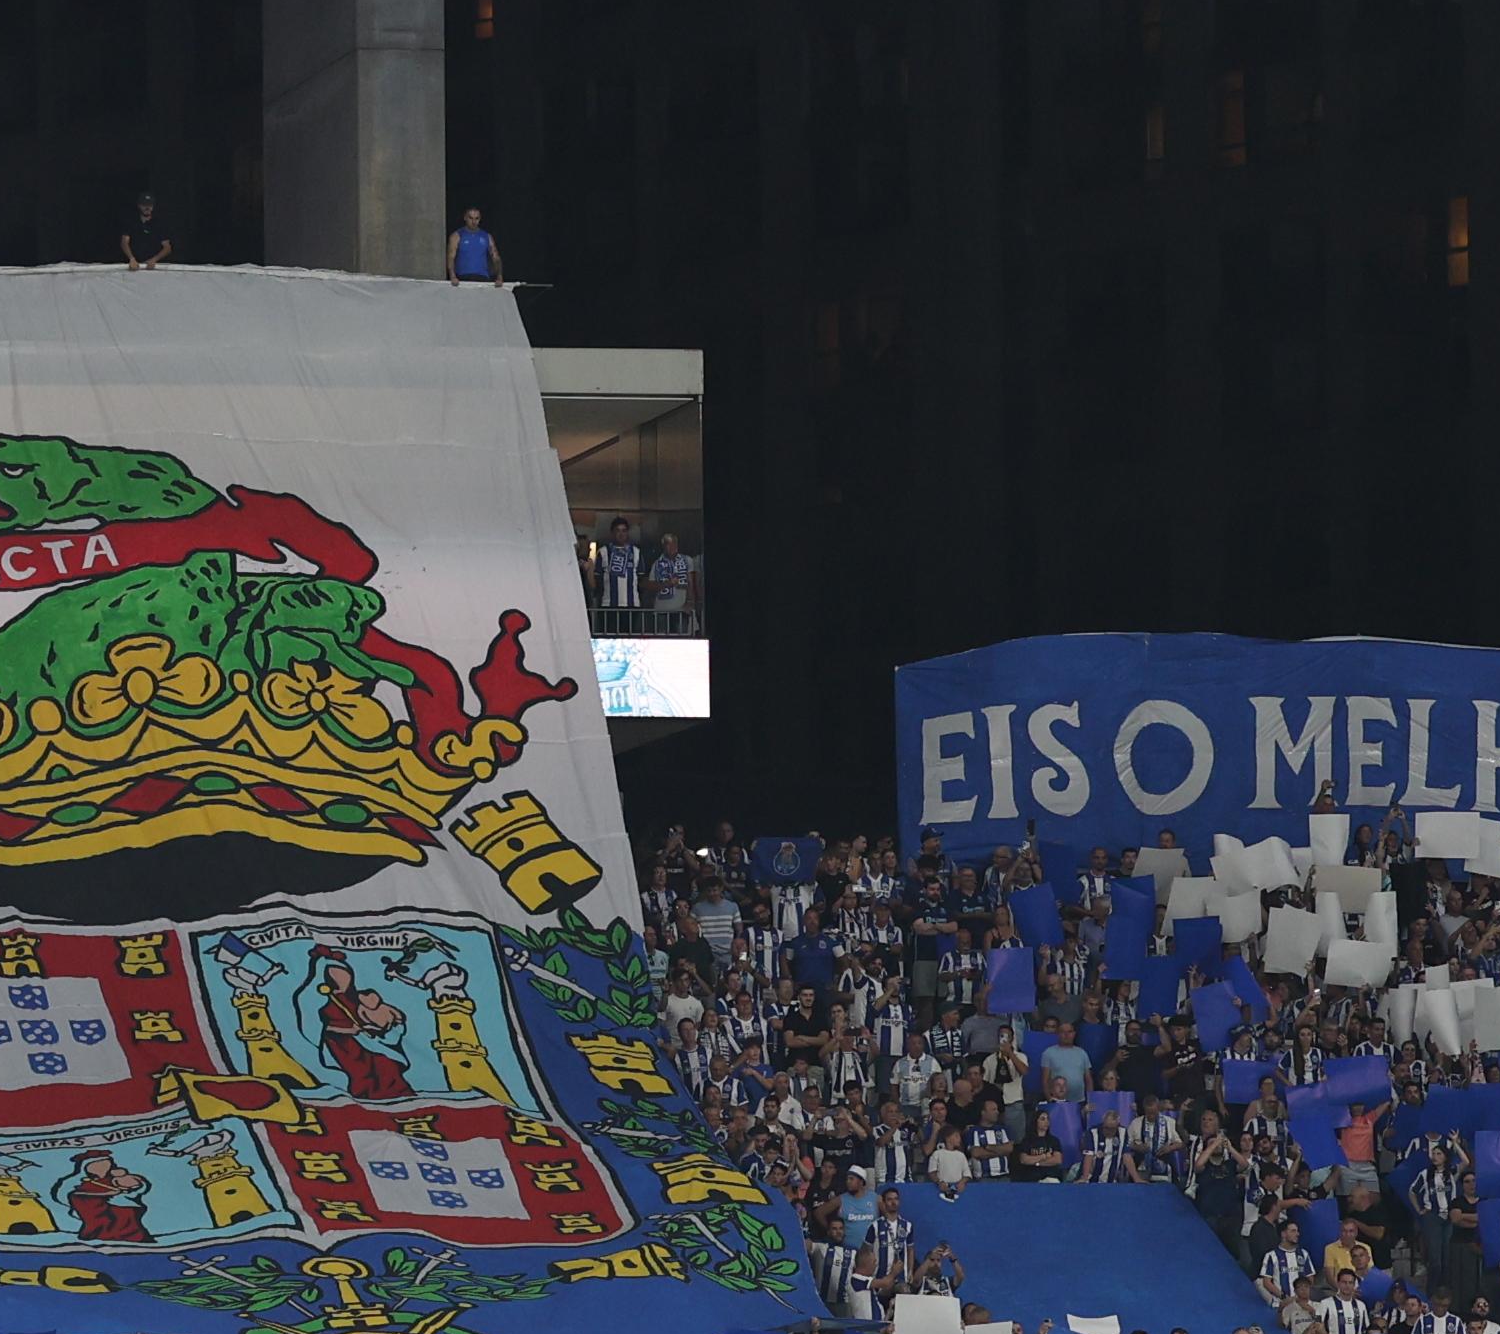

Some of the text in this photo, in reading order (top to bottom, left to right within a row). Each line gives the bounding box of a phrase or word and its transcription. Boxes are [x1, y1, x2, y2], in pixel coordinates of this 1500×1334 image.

[919, 699, 1091, 826] EIS
[1112, 699, 1214, 817] O
[247, 923, 410, 948] CIVITA VIRGINIS
[13, 1119, 182, 1152] CIVITAS VIRGINIS
